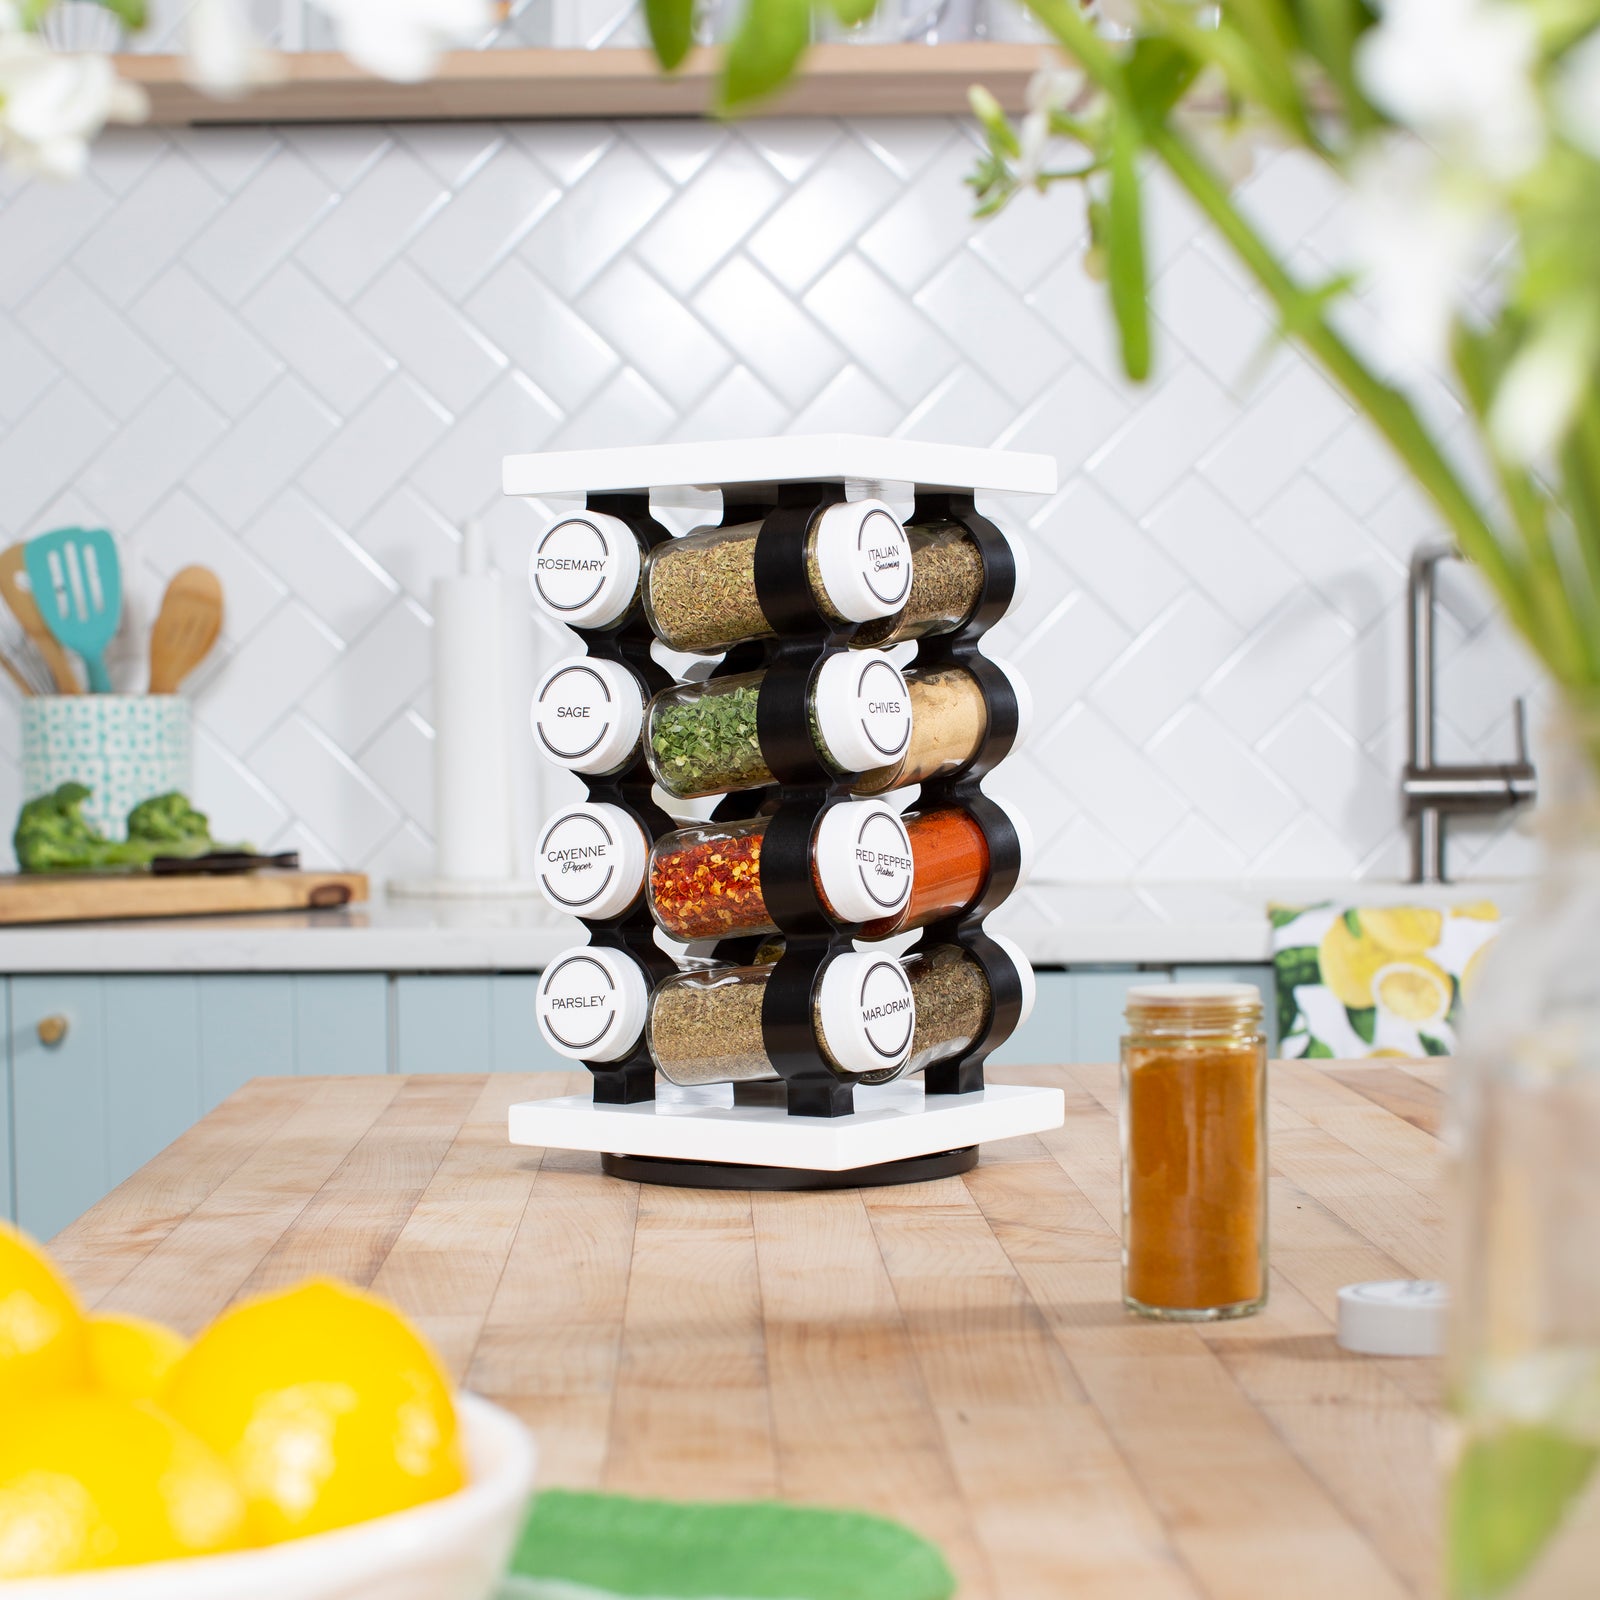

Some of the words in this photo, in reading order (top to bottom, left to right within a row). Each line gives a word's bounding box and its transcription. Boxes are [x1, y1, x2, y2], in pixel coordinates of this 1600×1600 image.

[868, 545, 900, 562] ITALIAN
[536, 557, 607, 572] ROSEMARY
[873, 560, 900, 573] Seasoning
[557, 706, 591, 718] SAGE
[868, 701, 901, 714] CHIVES
[547, 844, 607, 862] CAYENNE
[855, 848, 875, 862] RED
[877, 852, 912, 871] PEPPER
[561, 860, 592, 874] Pepper
[874, 863, 895, 878] Flakes
[552, 994, 606, 1010] PARSLEY
[862, 997, 911, 1022] MARJORAM
